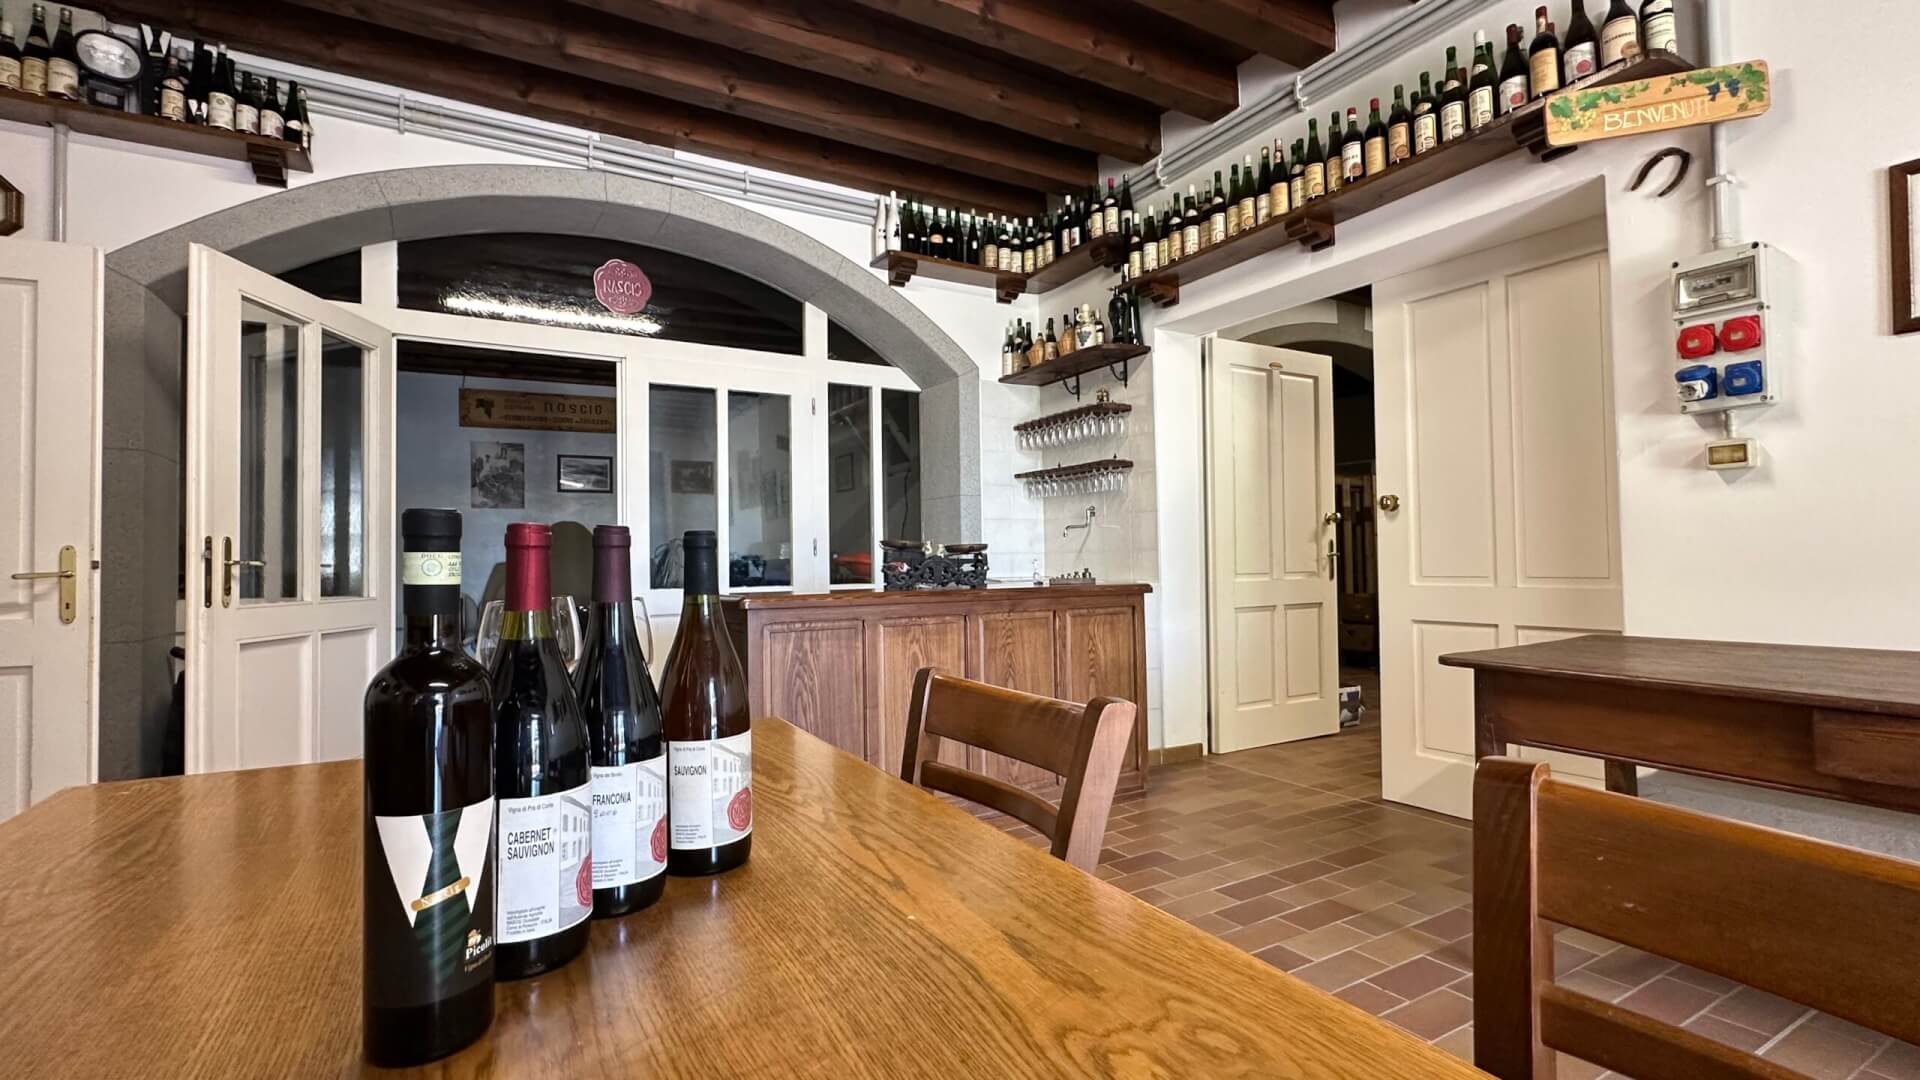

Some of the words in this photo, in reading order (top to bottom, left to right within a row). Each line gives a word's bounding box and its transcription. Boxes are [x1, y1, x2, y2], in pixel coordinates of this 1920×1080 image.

[1603, 98, 1710, 132] BENVENUTI
[674, 764, 707, 776] SAUVIGNON
[592, 791, 631, 806] FRANCONIA
[507, 827, 552, 846] CABERNET
[507, 842, 555, 861] SAUVIGNON
